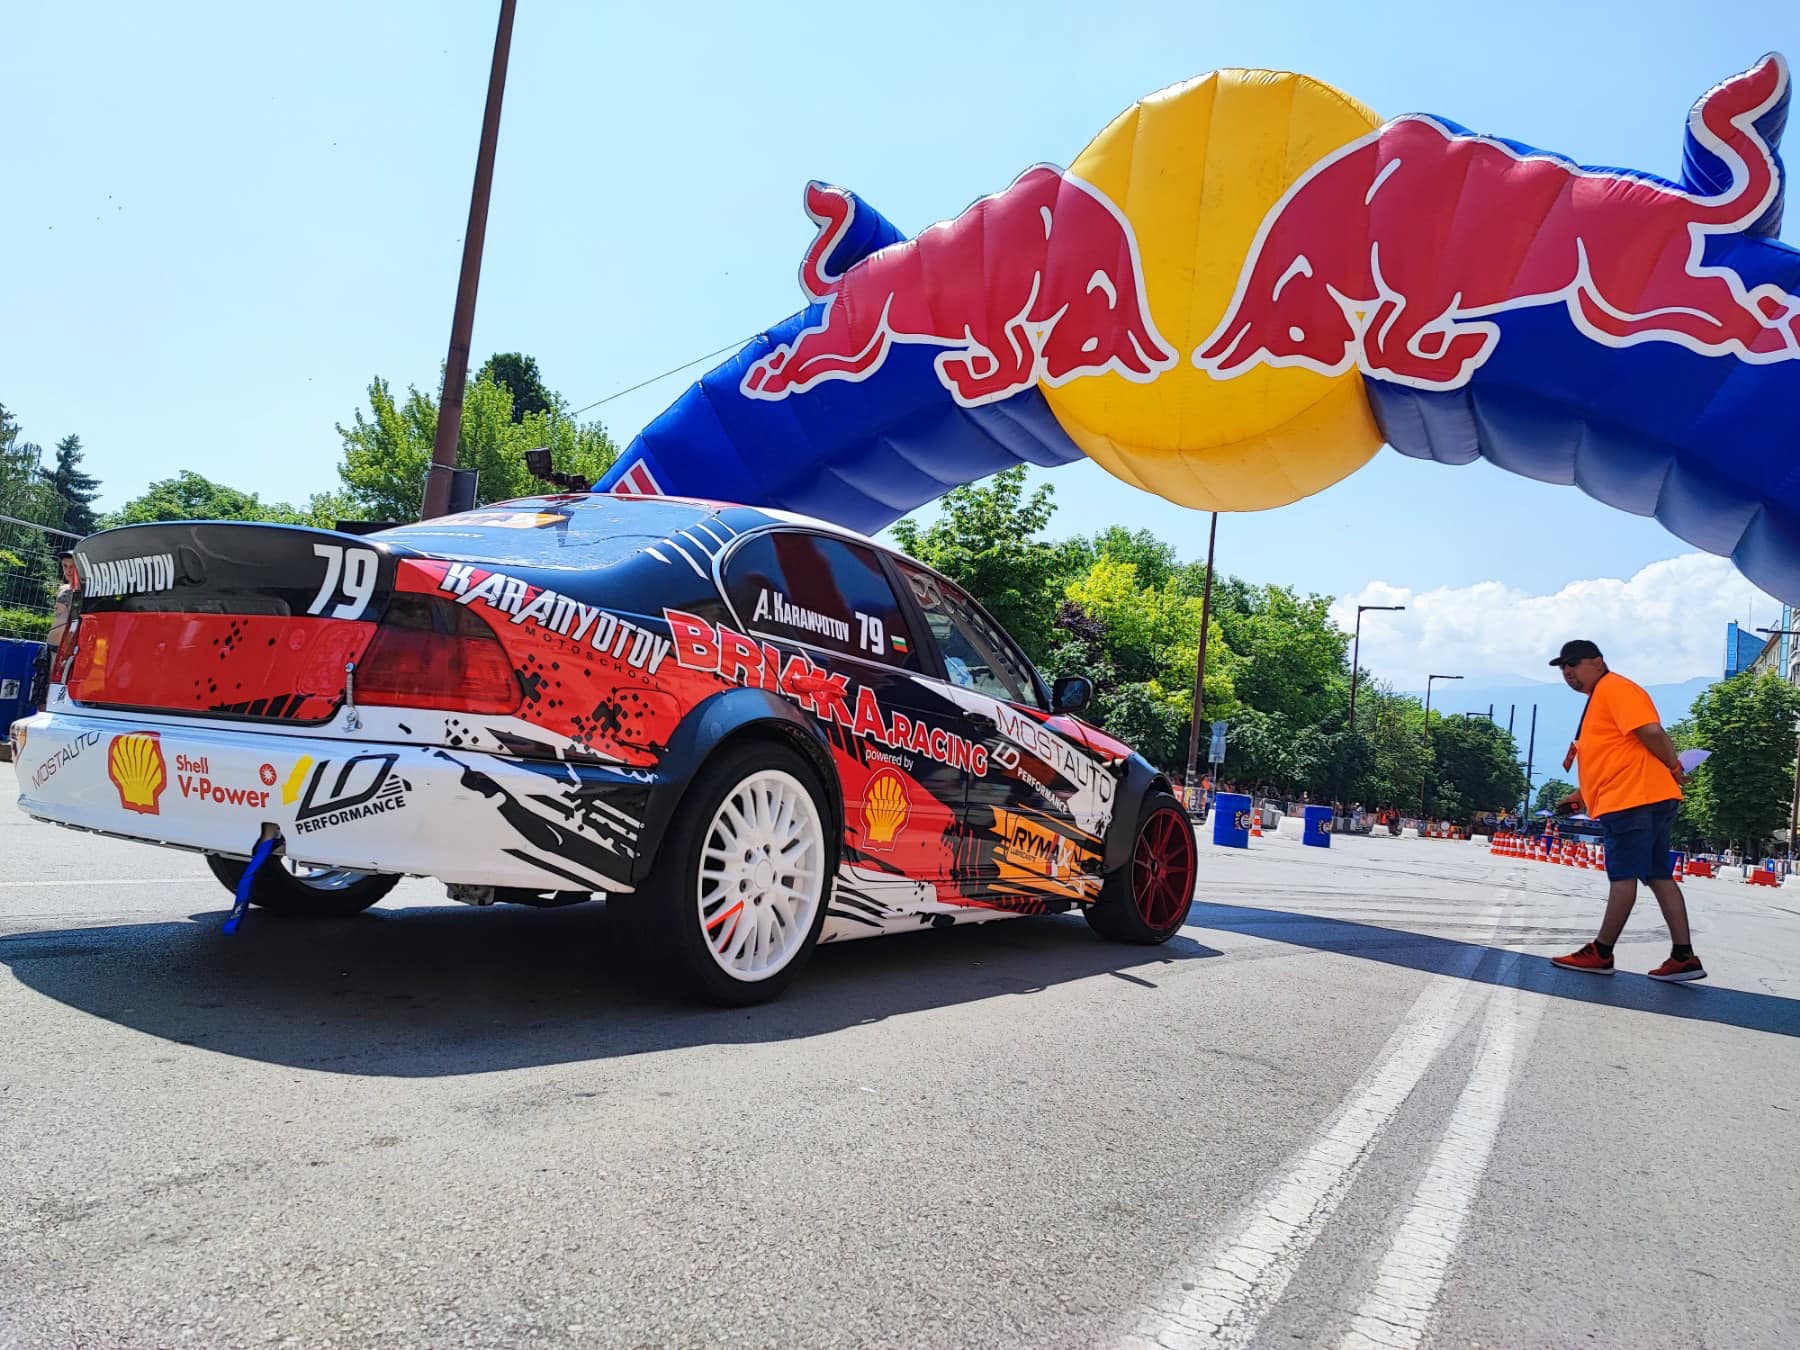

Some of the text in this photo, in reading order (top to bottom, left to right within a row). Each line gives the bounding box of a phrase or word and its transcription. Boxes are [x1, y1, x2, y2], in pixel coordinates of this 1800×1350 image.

[76, 552, 175, 598] KARANYOTOV
[306, 543, 379, 620] 79
[439, 562, 672, 676] KARANYOTOV
[854, 611, 885, 656] 79
[524, 625, 662, 691] MOTOSCHOOL
[31, 729, 104, 790] MOSTAUTO
[176, 754, 209, 775] Shell
[865, 749, 915, 772] powered by
[995, 705, 1112, 803] MOSTAUTO
[177, 774, 270, 809] V-Power
[1017, 766, 1070, 815] PERFORMANCE
[295, 794, 407, 836] PERFORMANCE
